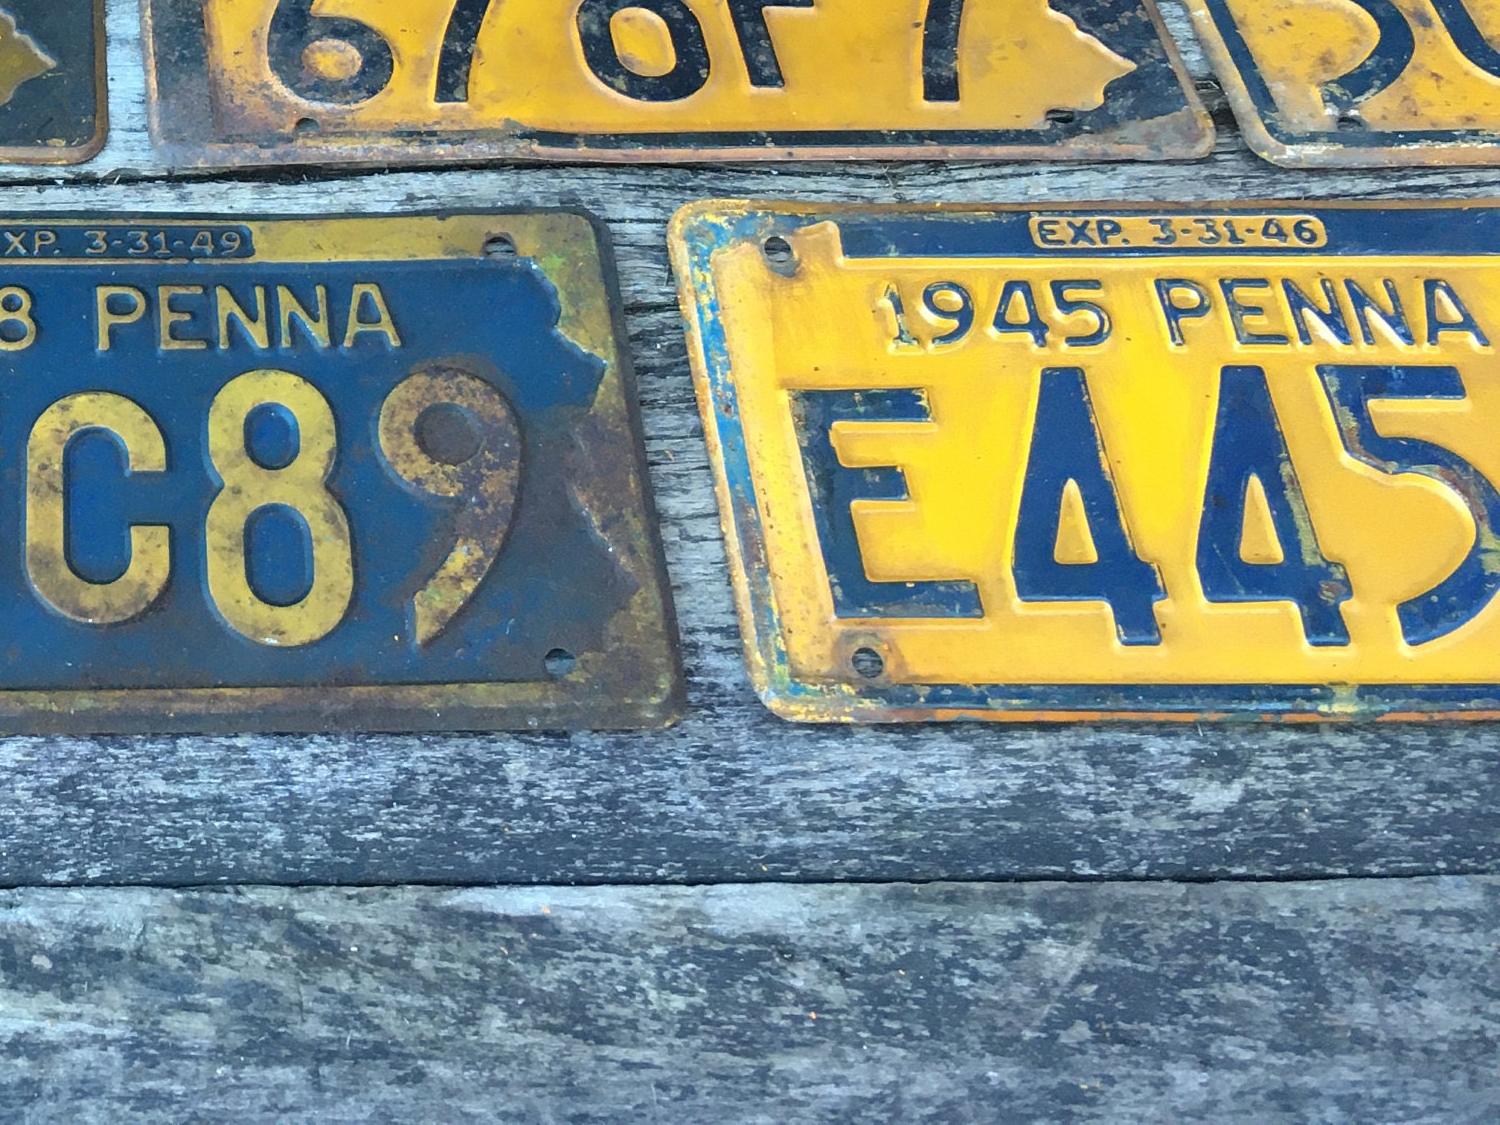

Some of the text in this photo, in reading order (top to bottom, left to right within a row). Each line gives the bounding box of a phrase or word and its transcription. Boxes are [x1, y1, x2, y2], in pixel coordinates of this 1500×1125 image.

[84, 230, 243, 257] 3-31-49
[1036, 219, 1320, 246] EXP. 3-31-46
[95, 283, 402, 352] PENNA
[878, 278, 1492, 348] 1945 PENNA
